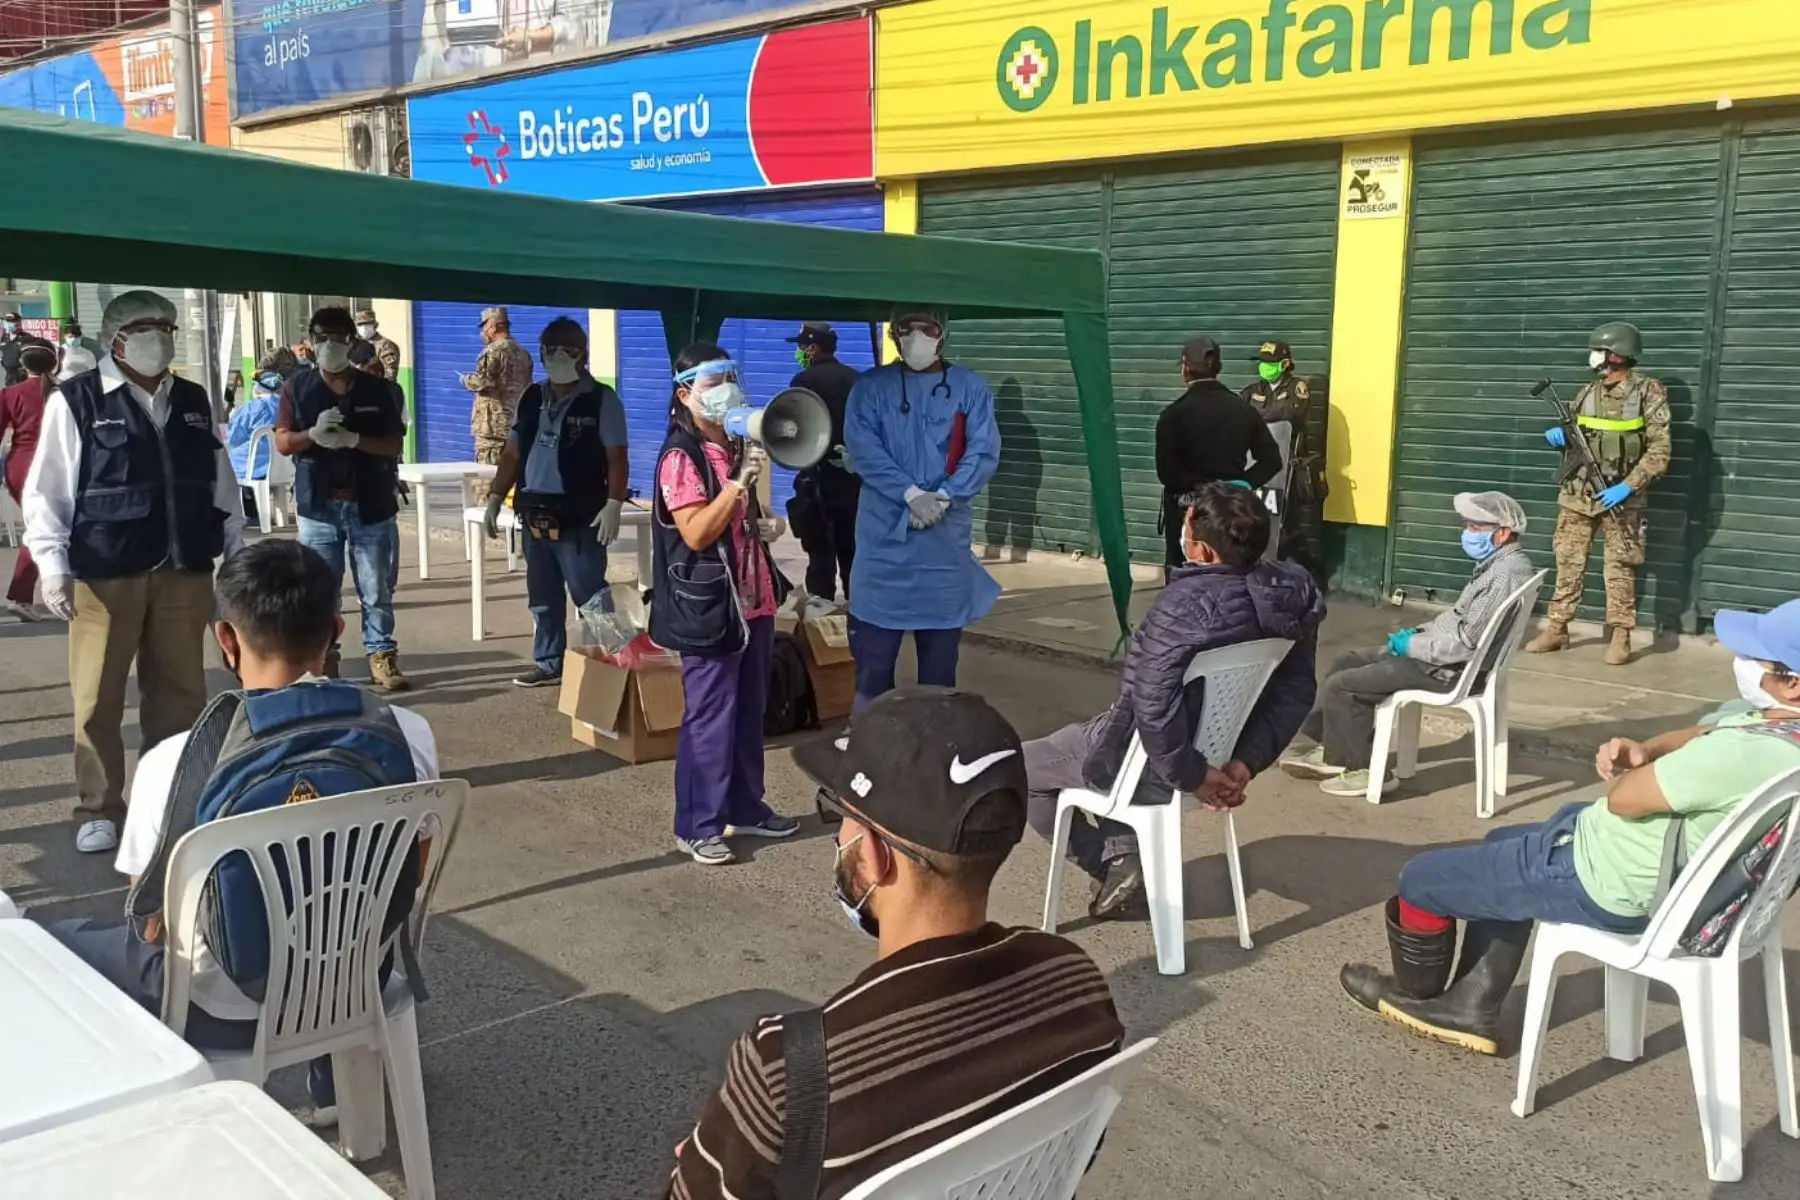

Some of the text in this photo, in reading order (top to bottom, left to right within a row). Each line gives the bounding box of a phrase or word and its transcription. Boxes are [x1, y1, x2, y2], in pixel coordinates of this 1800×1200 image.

[264, 27, 310, 70] al país
[1073, 0, 1591, 105] Inkafarma
[519, 91, 710, 159] Boticas Perú
[630, 147, 711, 172] salud y economía
[1347, 202, 1398, 213] PROSEGUR
